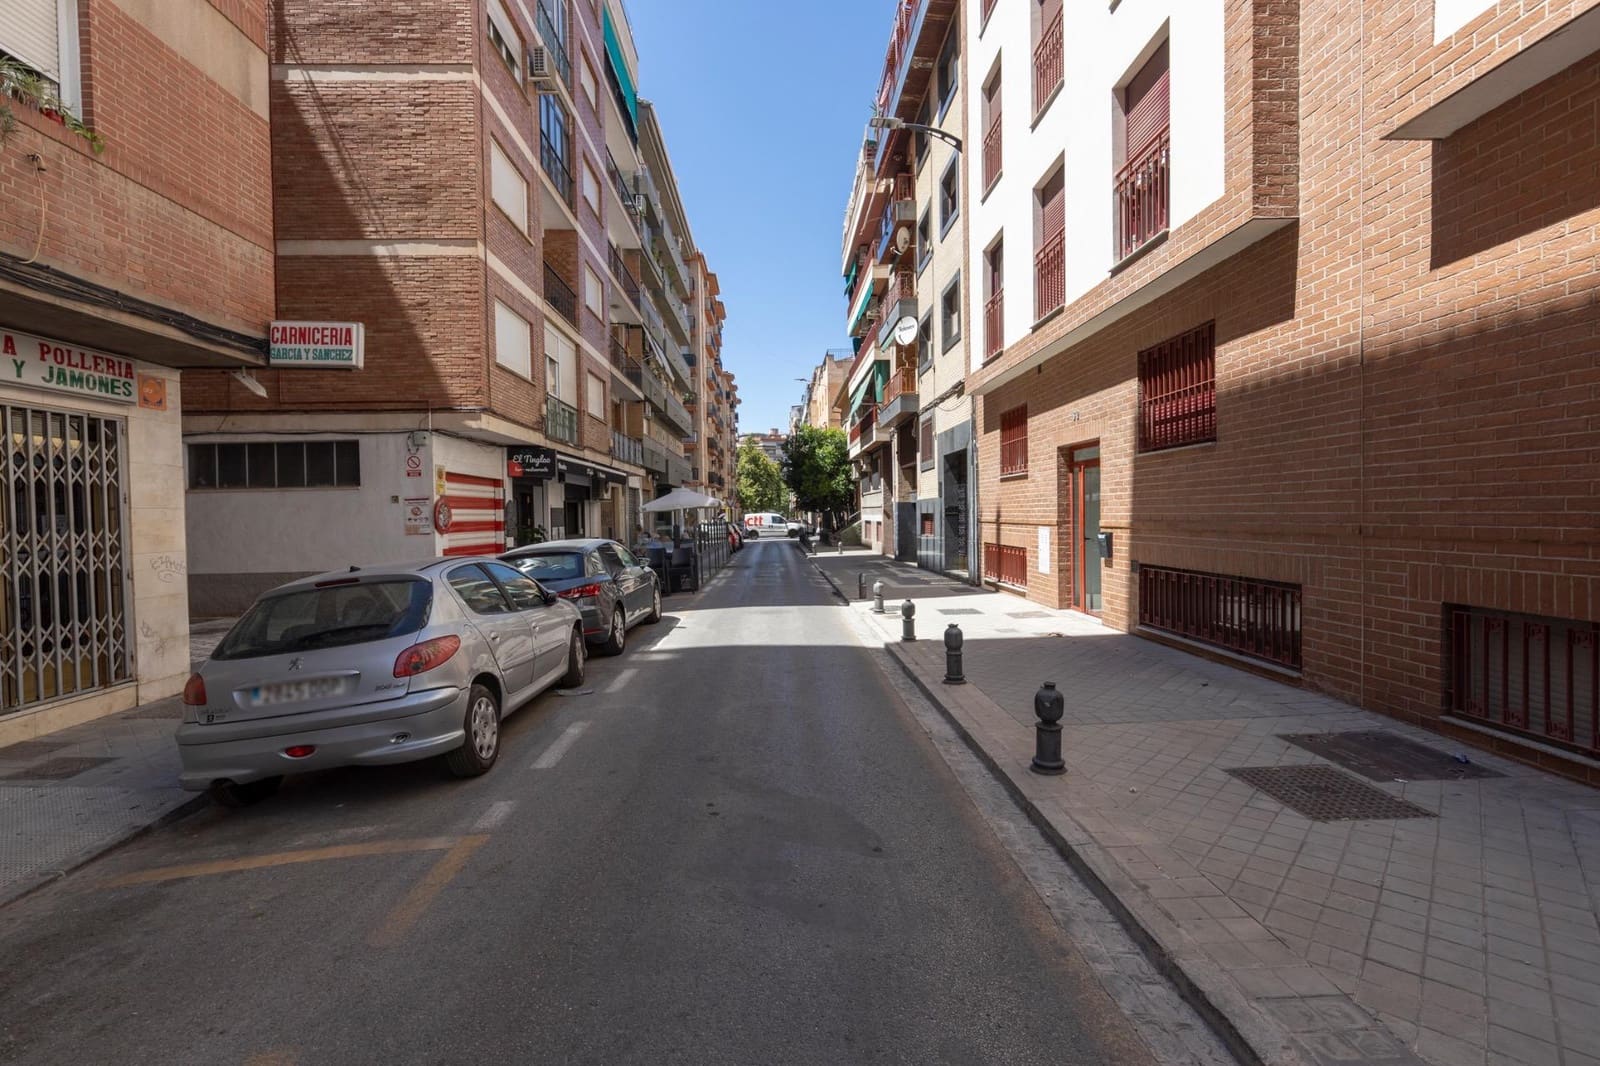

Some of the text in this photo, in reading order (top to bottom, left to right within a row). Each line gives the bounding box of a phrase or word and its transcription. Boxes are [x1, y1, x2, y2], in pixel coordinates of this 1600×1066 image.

[271, 326, 352, 345] CARNICERIA
[2, 334, 134, 379] A POLLERIA
[270, 347, 353, 361] GARCIA Y SANCHEZ
[12, 358, 133, 397] Y JAMONES
